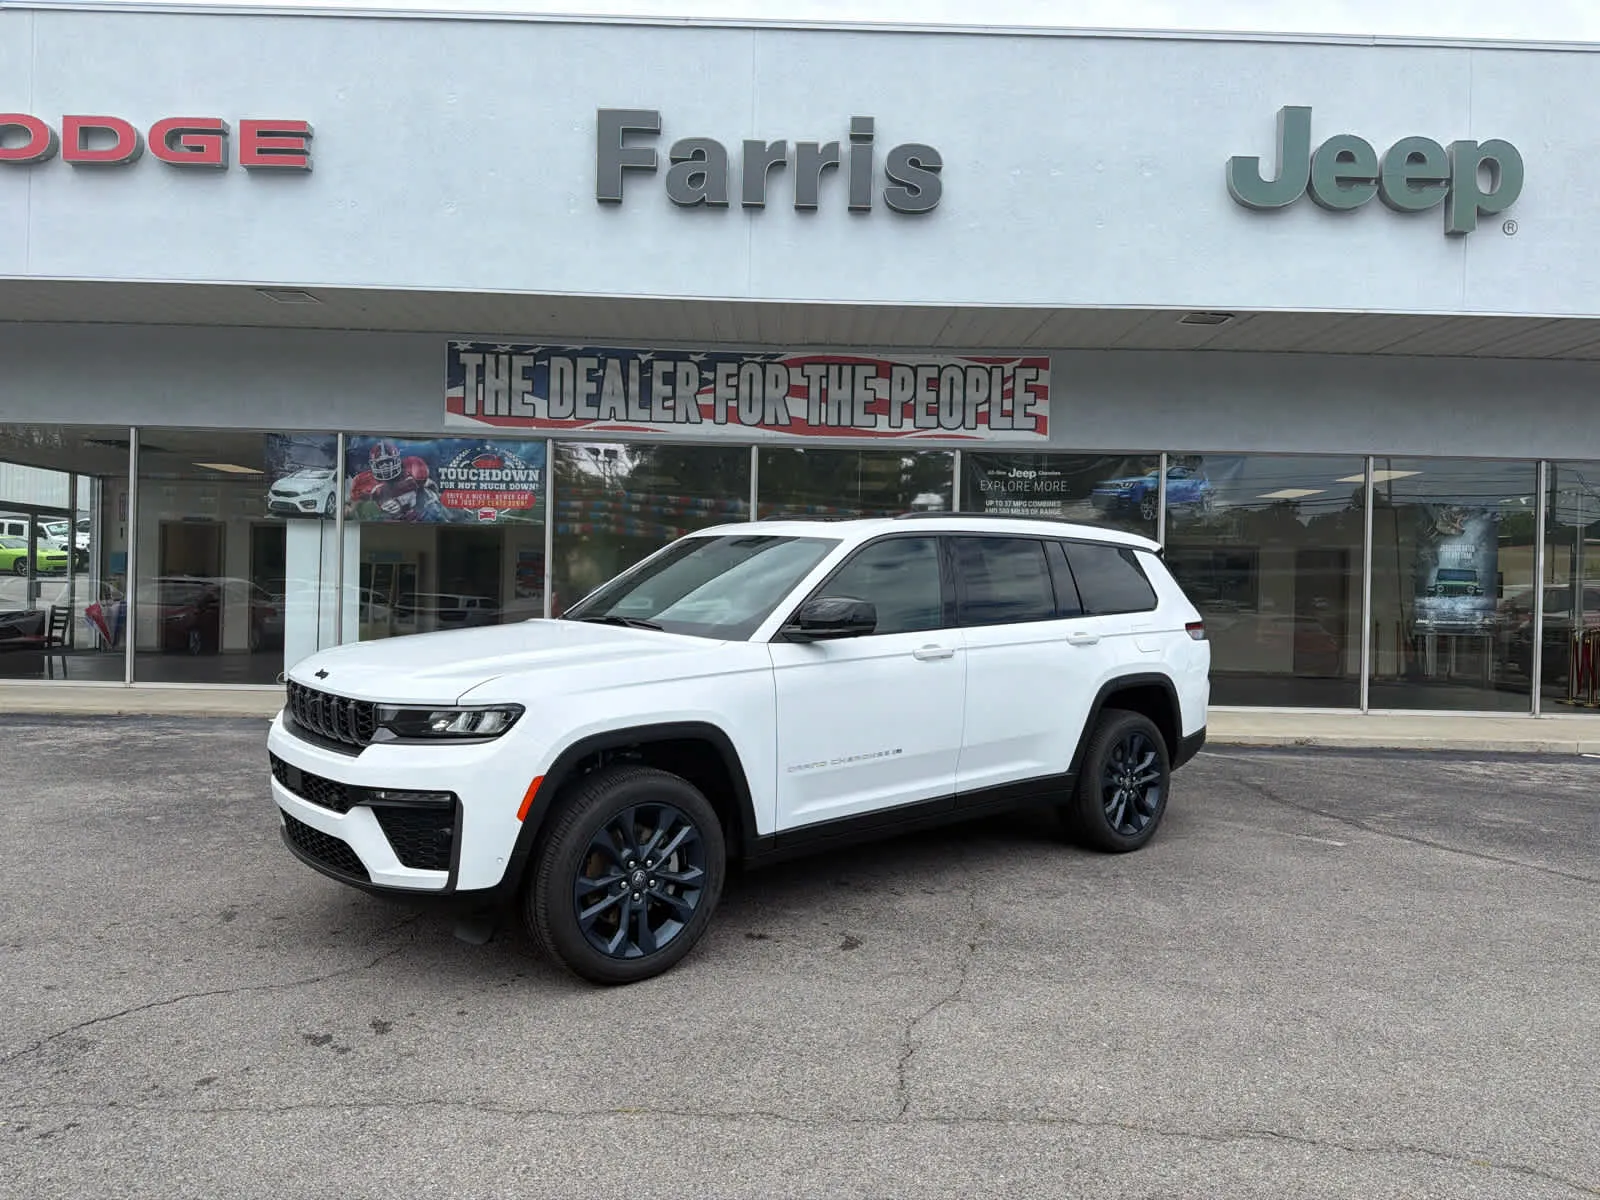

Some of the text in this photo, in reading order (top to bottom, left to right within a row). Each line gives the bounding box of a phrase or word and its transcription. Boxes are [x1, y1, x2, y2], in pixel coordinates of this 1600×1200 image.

[596, 108, 943, 214] Farris
[1225, 105, 1524, 235] Jeep
[459, 352, 1039, 430] THE DEALER FOR THE PEOPLE
[438, 467, 540, 482] TOUCHDOWN
[1008, 467, 1037, 479] Jeep
[440, 481, 539, 491] FOR NOT MUCH DOWN!
[980, 480, 1031, 492] EXPLORE
